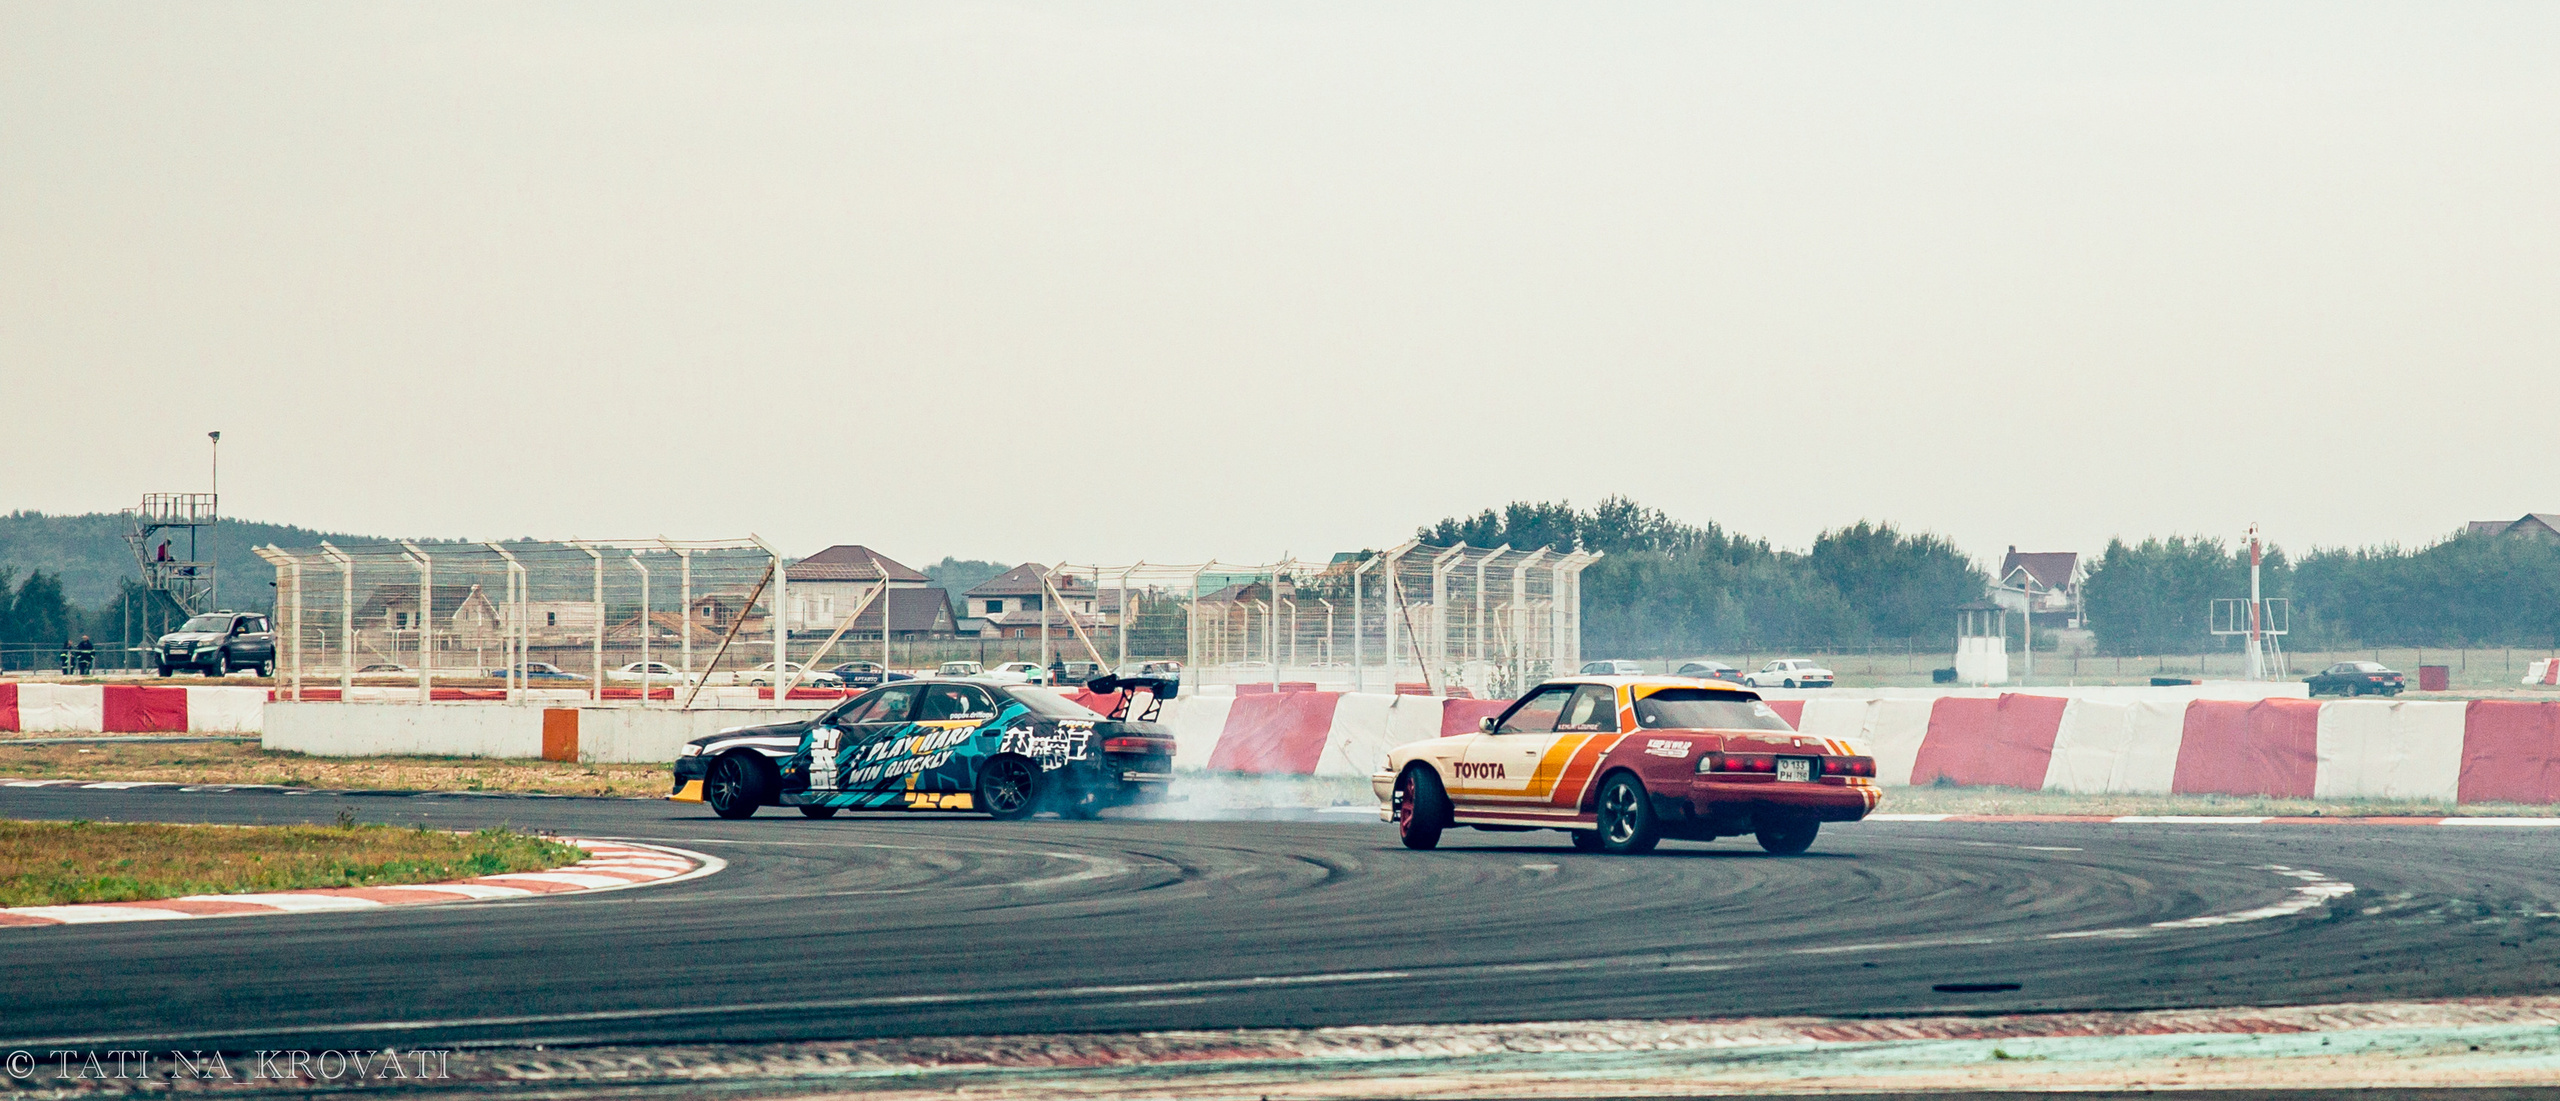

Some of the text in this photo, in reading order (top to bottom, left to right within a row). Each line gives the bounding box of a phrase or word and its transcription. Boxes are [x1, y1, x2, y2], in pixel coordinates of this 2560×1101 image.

[866, 735, 920, 762] PLAY
[918, 726, 975, 752] HARD
[849, 750, 954, 784] WIN QUICKLY
[1453, 762, 1506, 779] TOYOTA
